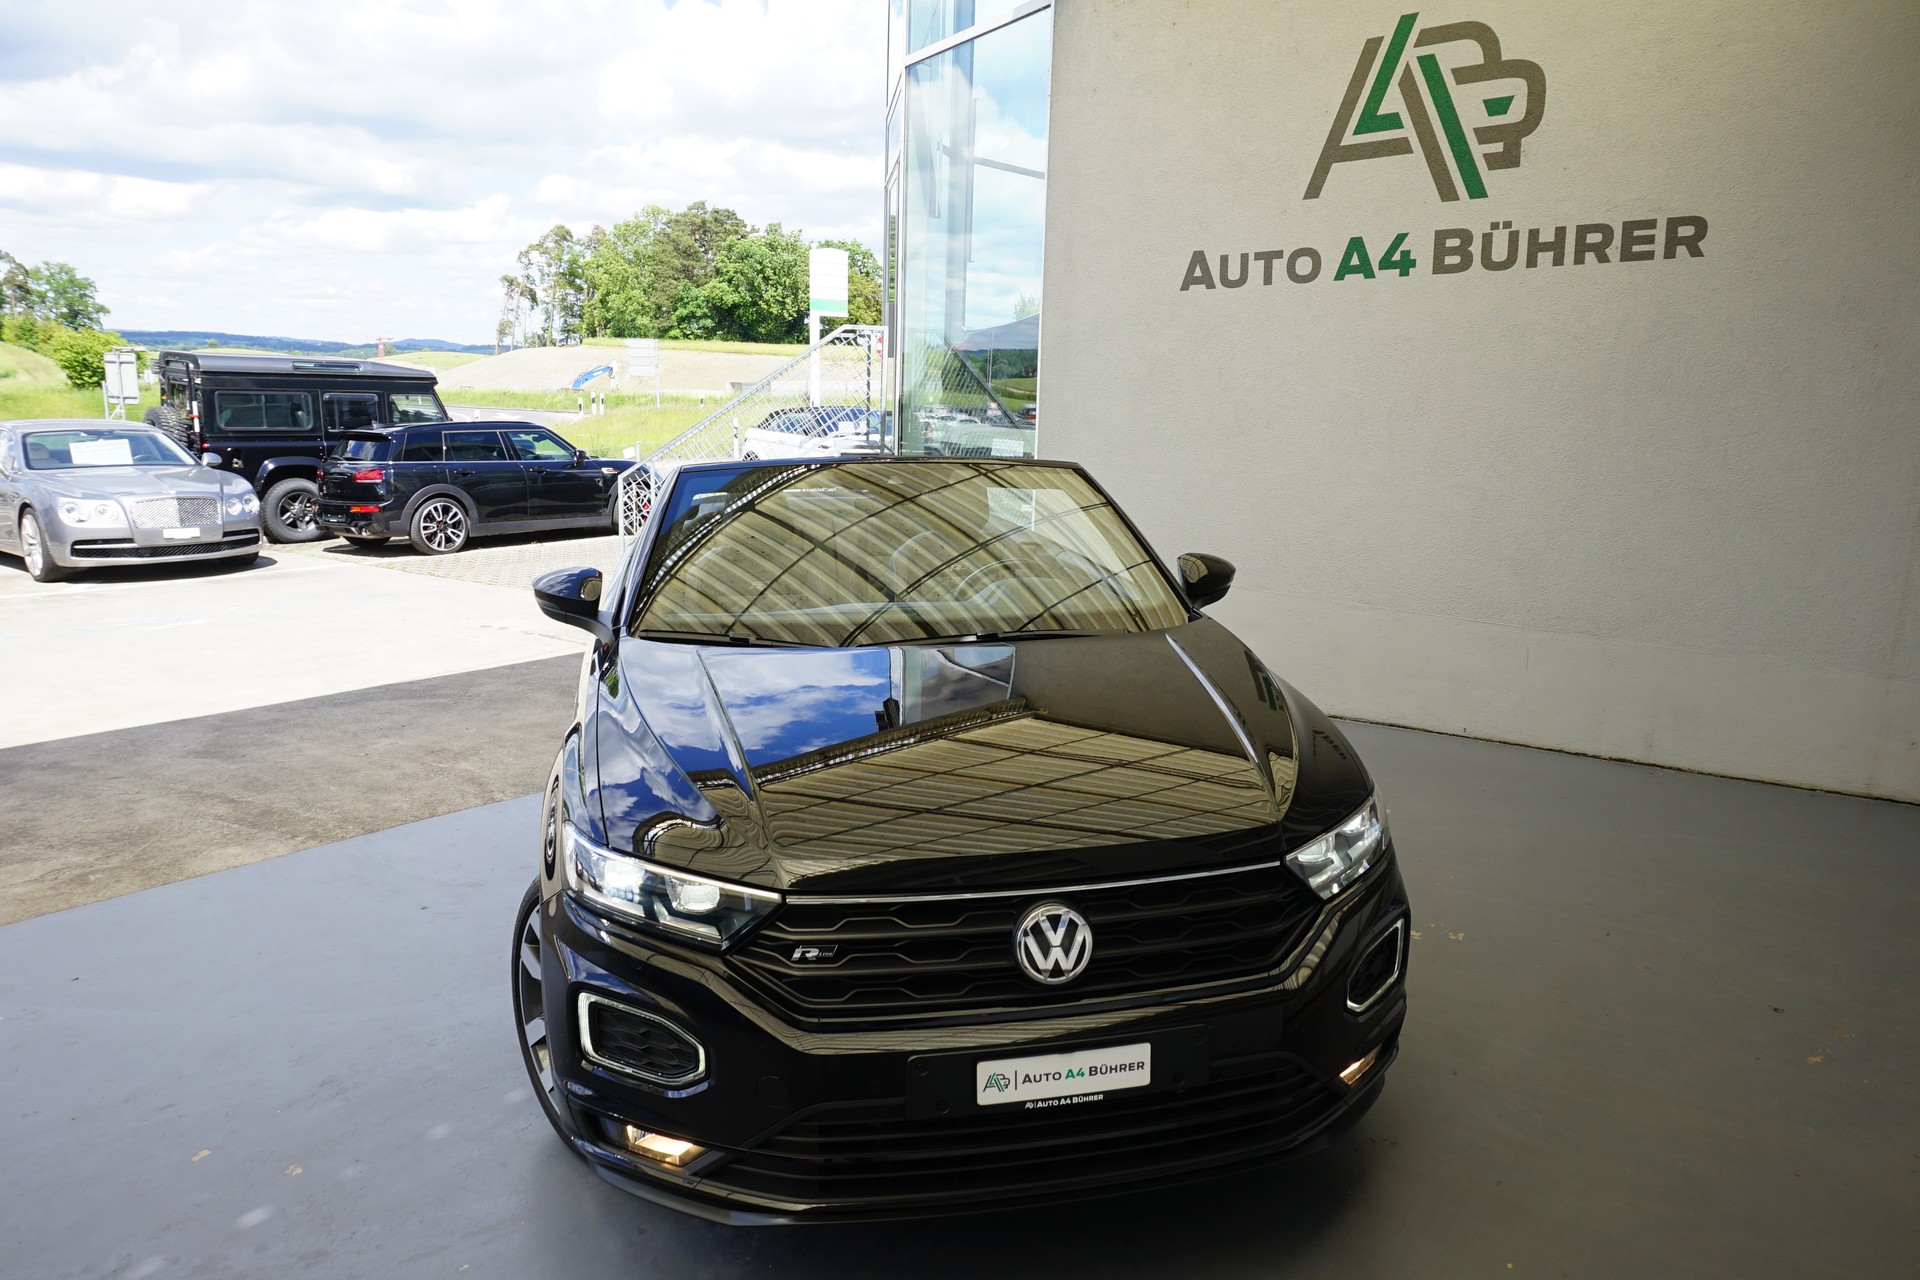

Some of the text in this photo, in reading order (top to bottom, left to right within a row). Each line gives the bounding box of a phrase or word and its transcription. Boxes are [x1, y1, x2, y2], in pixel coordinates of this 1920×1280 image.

[1179, 215, 1709, 292] AUTO A4 BÜHRER
[1022, 1071, 1062, 1085] AUTO
[1065, 1067, 1086, 1080] A4
[1088, 1061, 1146, 1077] BÜHRER
[1037, 1099, 1059, 1109] AUTO
[1060, 1097, 1072, 1105] A4
